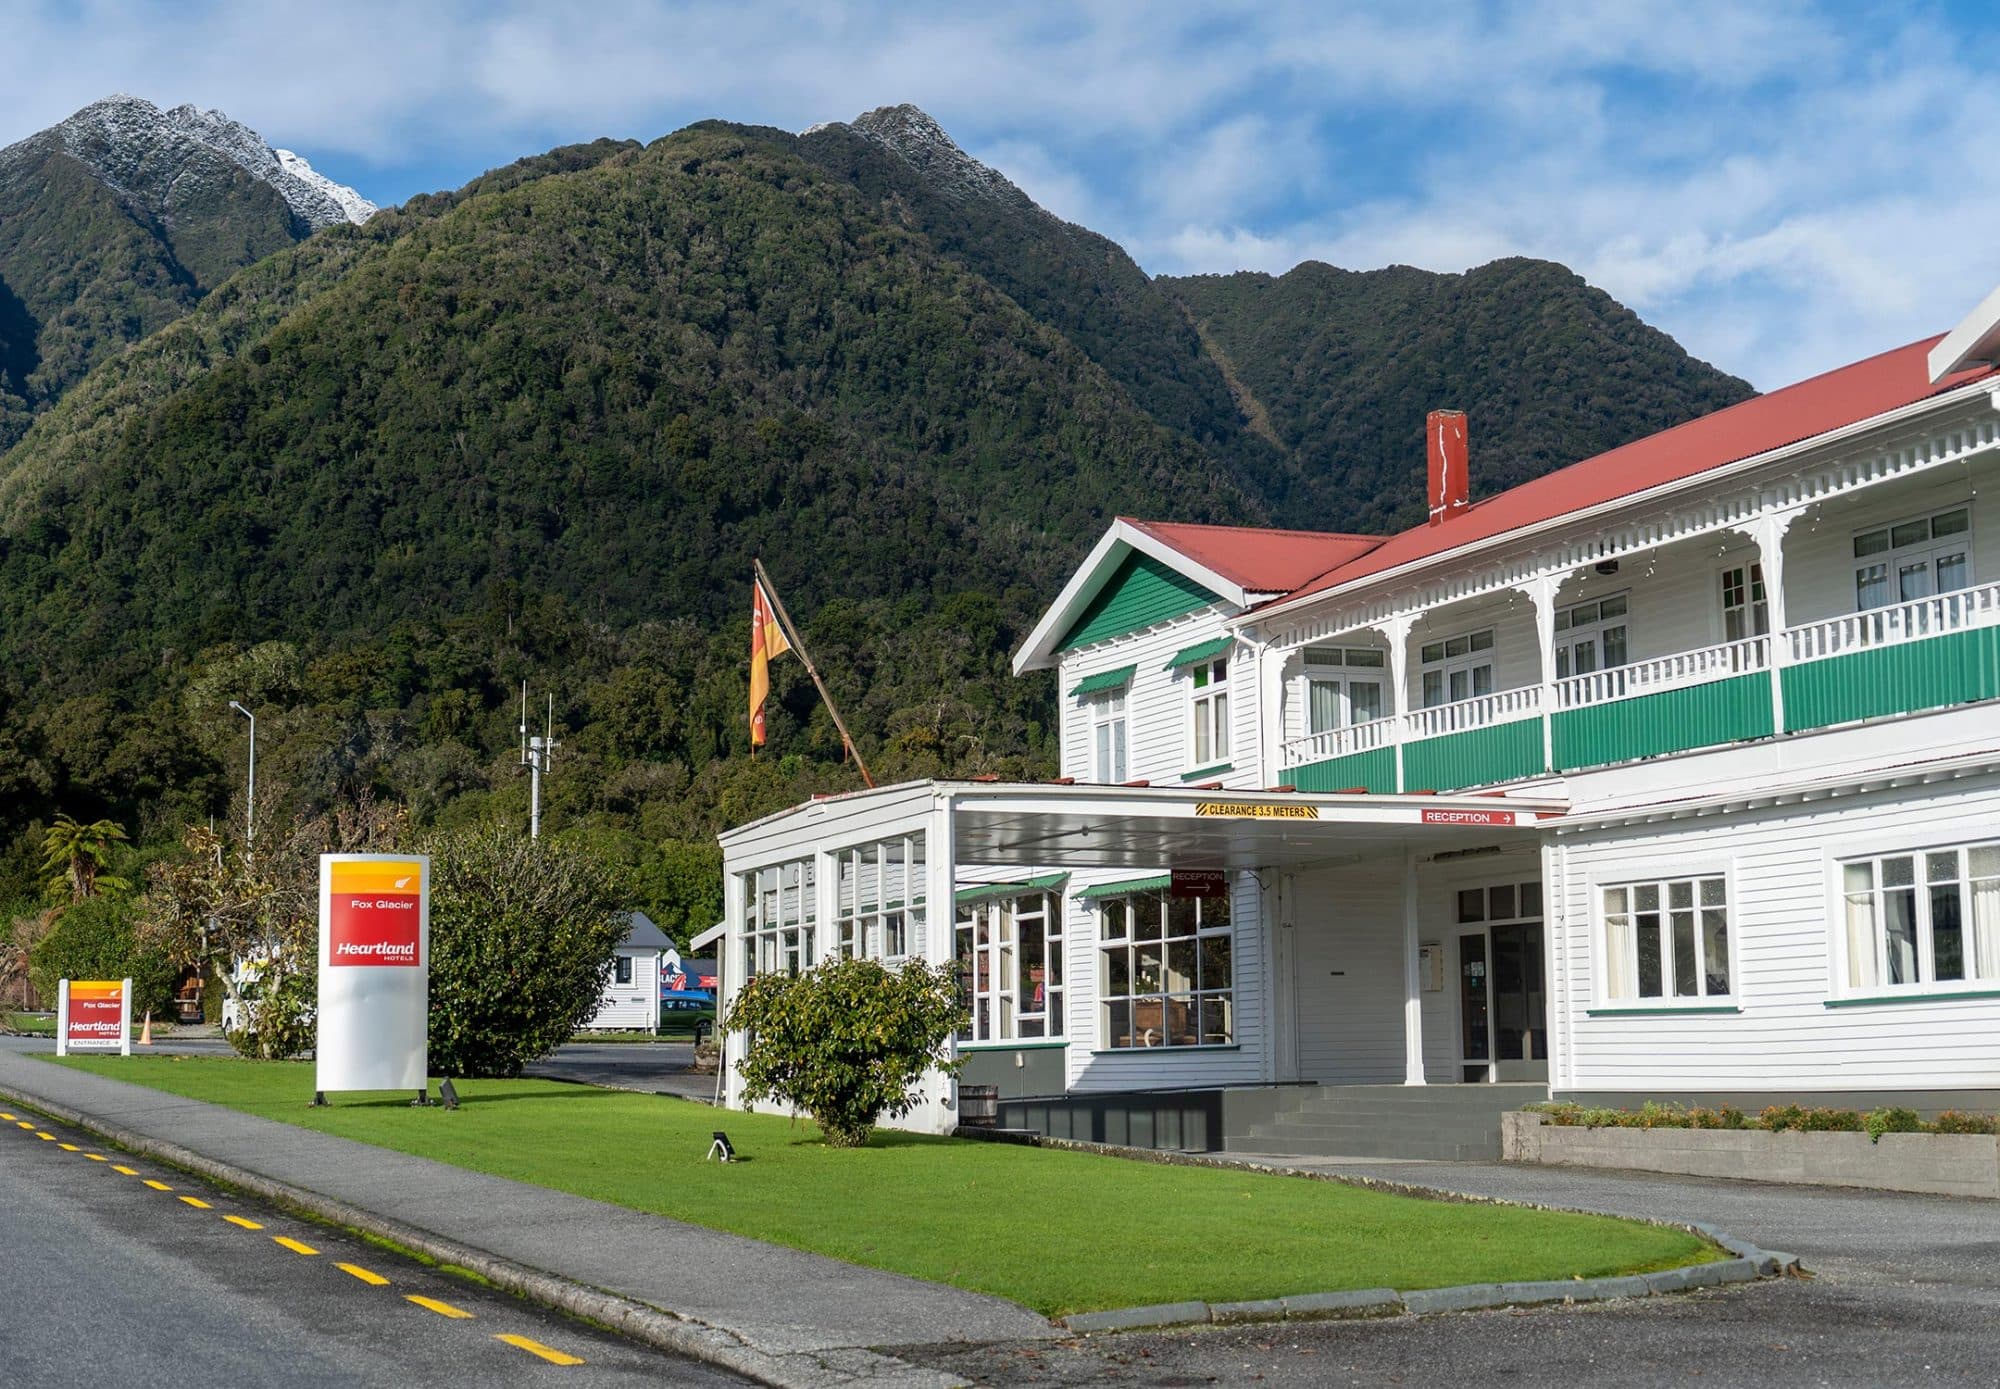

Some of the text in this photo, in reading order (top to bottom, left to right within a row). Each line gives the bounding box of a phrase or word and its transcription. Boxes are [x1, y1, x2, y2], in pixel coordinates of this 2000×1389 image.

[1209, 805, 1305, 817] CLEARANCE 3.5 METERS
[1426, 812, 1490, 822] RECEPTION
[1173, 872, 1223, 880] RECEPTION
[351, 900, 413, 909] Fox Glacier
[336, 941, 415, 955] Heartland
[69, 1021, 120, 1031] Heartland
